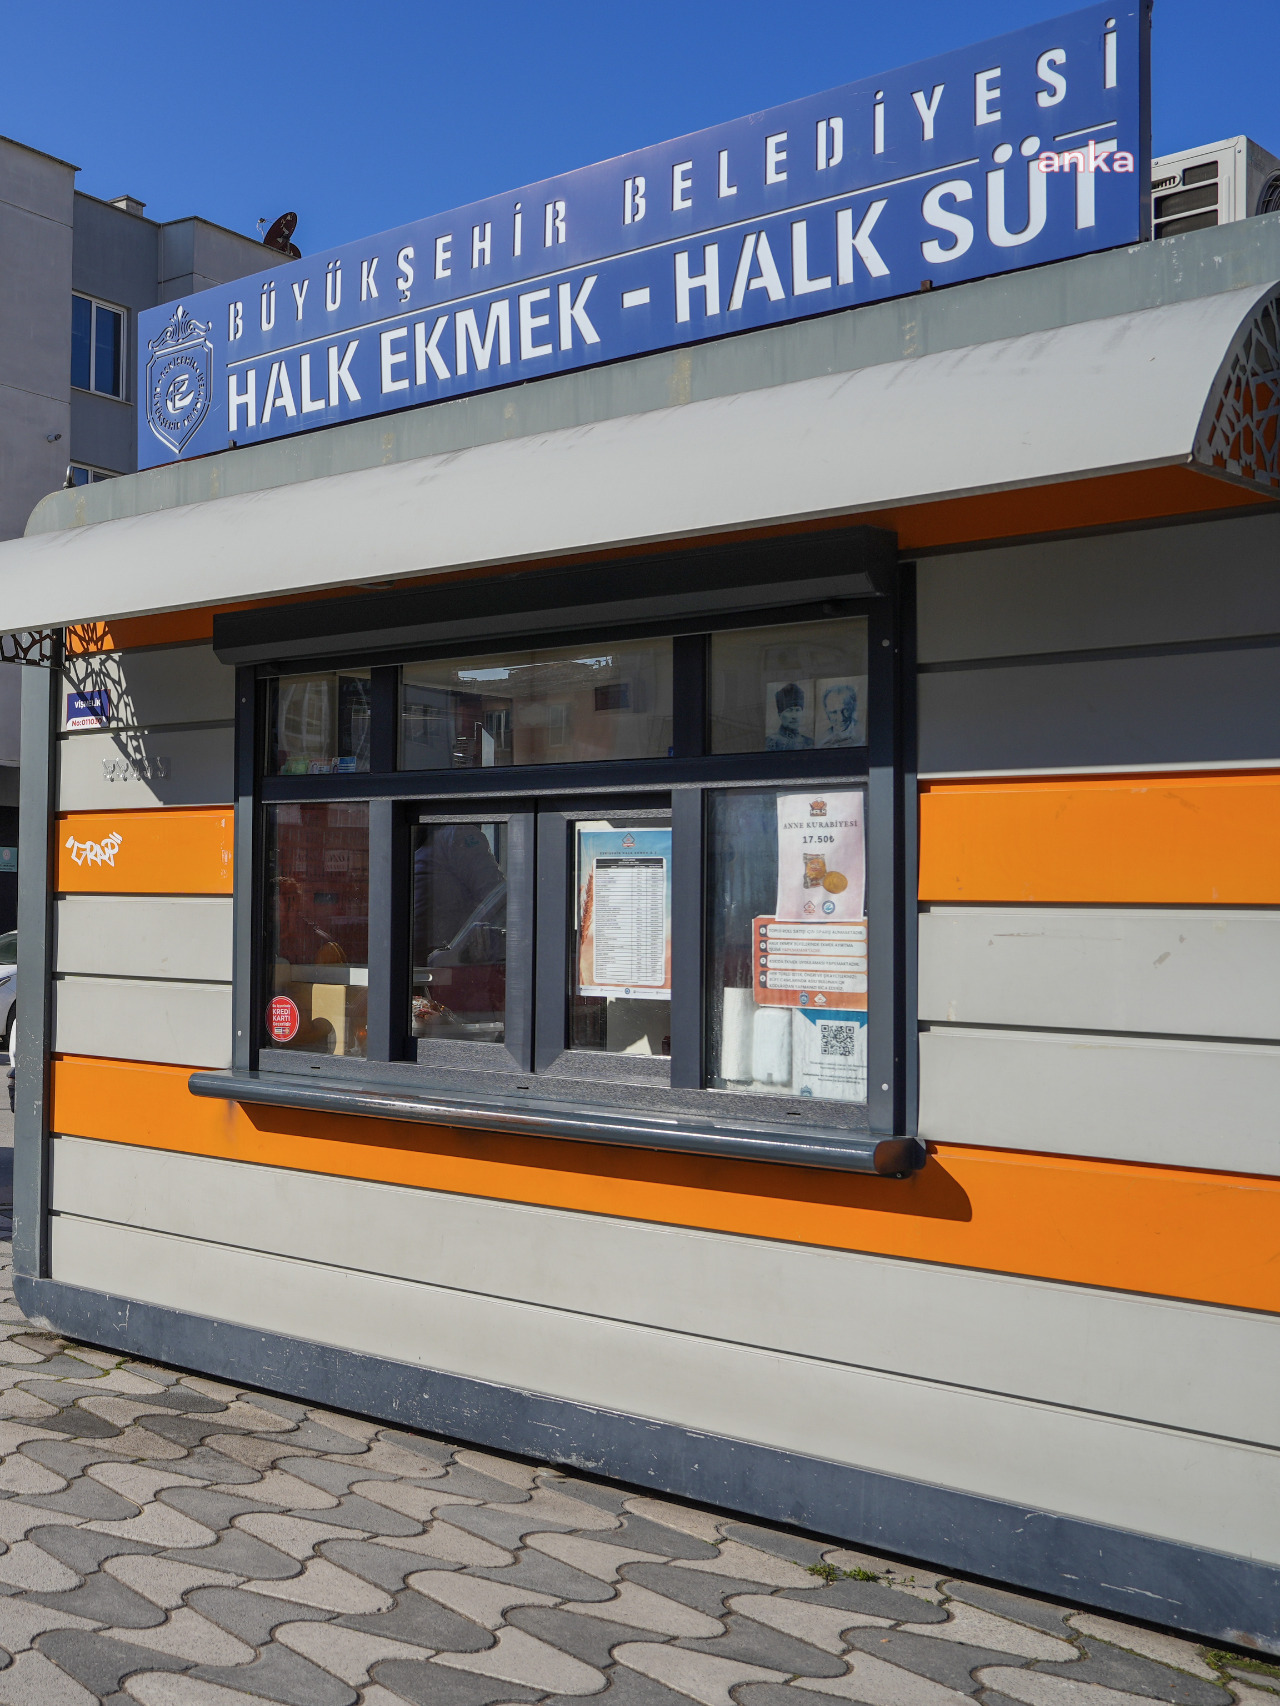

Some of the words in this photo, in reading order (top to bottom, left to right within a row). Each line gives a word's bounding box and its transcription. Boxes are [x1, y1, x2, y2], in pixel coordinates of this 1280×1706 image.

[228, 200, 566, 341] BÜYÜKŞEHİR
[623, 17, 1117, 225] BELEDİYESİ
[228, 339, 361, 432] HALK
[380, 274, 601, 394] EKMEK
[674, 198, 891, 323] HALK
[921, 135, 1118, 264] SÜT
[783, 822, 804, 830] ANNE
[806, 819, 858, 829] KURABİYESİ
[272, 1007, 291, 1015] KREDİ
